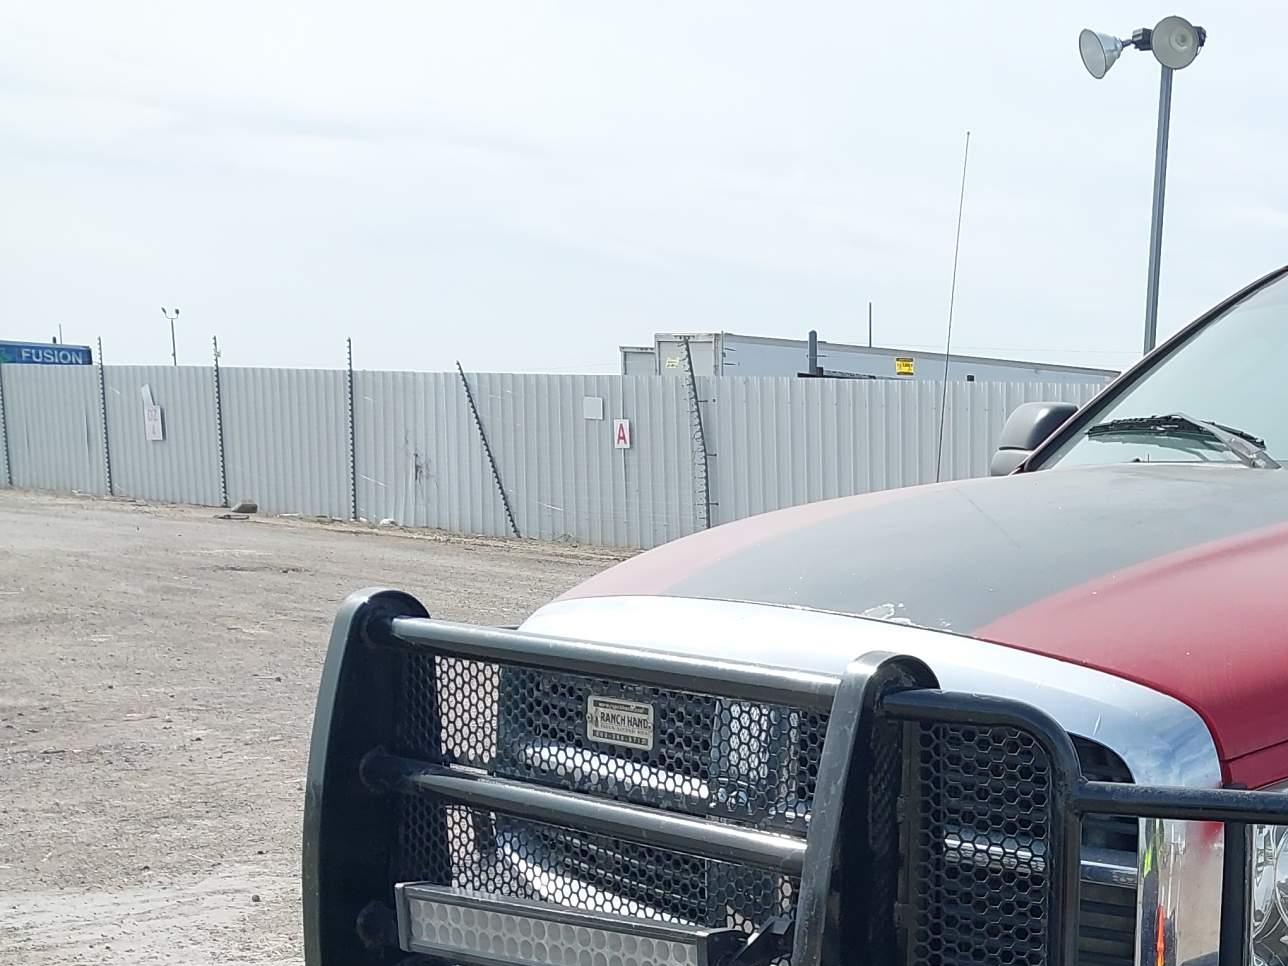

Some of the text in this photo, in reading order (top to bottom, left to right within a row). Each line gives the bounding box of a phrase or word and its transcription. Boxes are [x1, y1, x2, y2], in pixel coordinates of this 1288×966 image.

[21, 348, 83, 364] FUSION
[616, 422, 628, 445] A
[600, 711, 626, 727] RANCH
